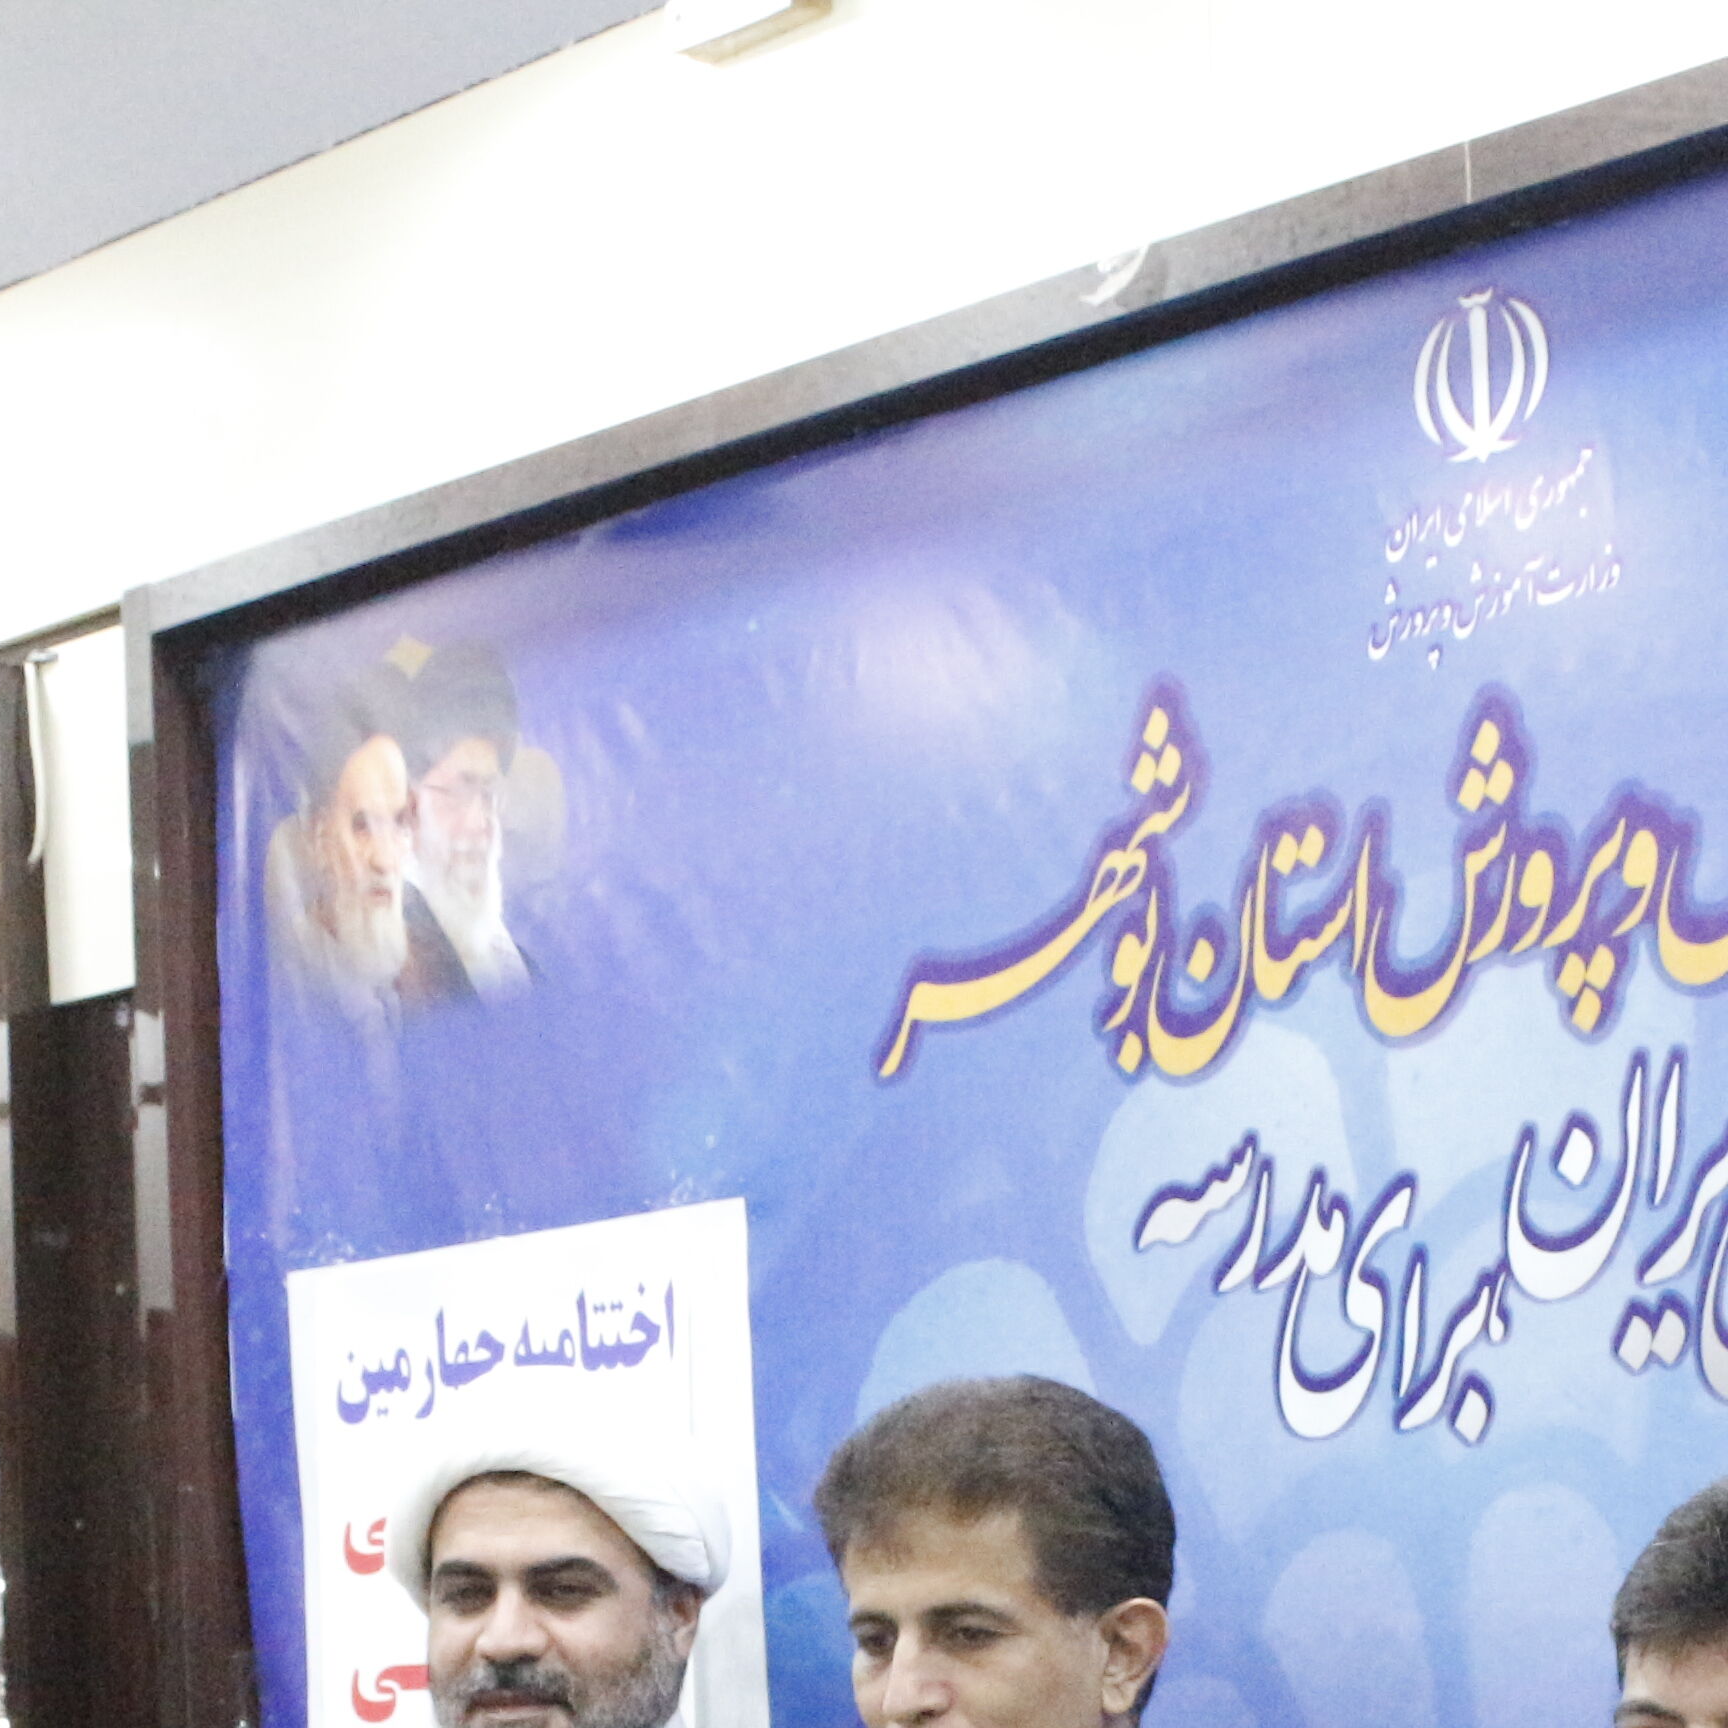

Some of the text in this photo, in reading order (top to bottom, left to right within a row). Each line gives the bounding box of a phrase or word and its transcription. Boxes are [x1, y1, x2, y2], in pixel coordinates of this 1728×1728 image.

[1385, 448, 1593, 569] جمهوری اسلامی ایران
[1536, 543, 1622, 606] وزارت
[1367, 577, 1442, 671] پرورش
[1453, 556, 1546, 639] آموزش
[878, 706, 1190, 1078] بوشهر
[1148, 826, 1372, 1076] استان
[1364, 719, 1626, 1036] پرورش
[1136, 1142, 1345, 1293] مدرسه
[1278, 1185, 1491, 1443] برای
